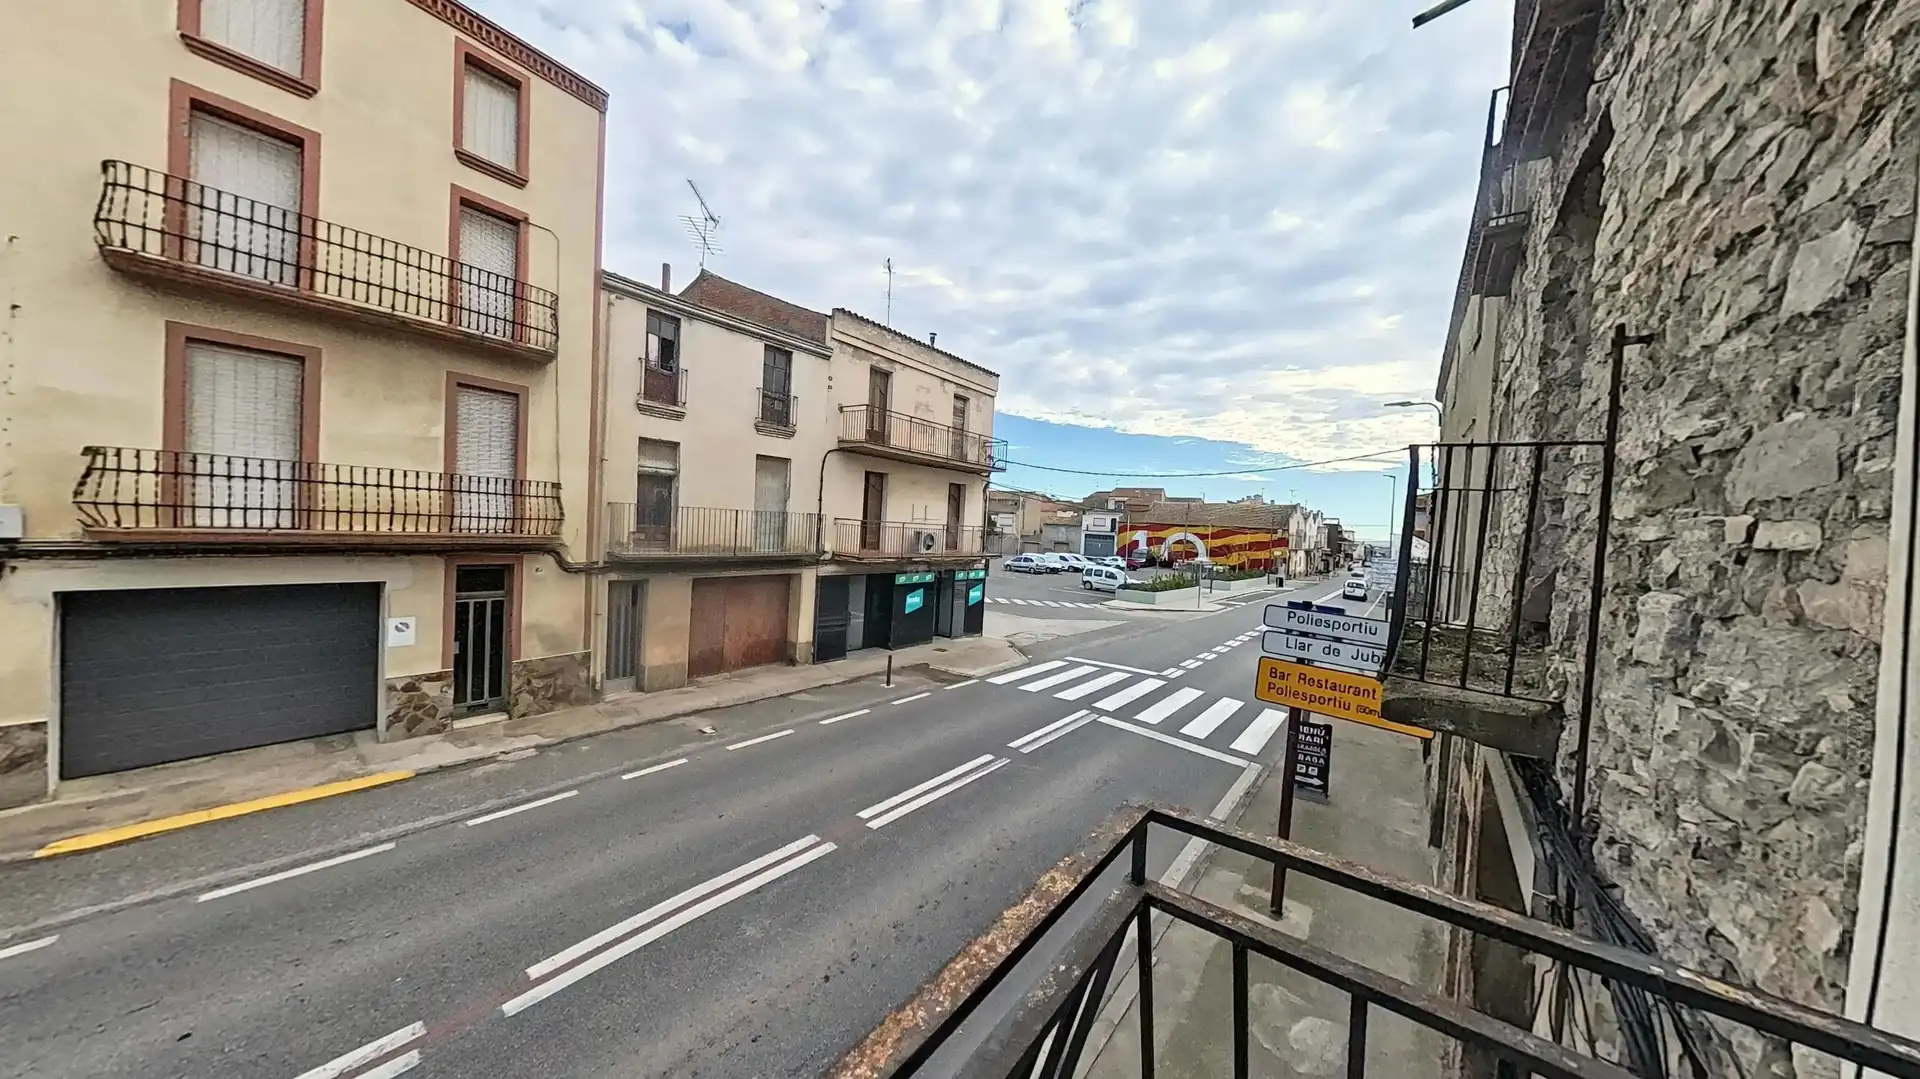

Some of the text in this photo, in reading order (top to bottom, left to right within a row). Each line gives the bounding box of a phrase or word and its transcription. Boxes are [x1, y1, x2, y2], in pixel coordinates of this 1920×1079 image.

[1287, 610, 1378, 636] Poliesportiu
[1285, 637, 1381, 664] Llar de Jub
[1267, 682, 1351, 712] Poliesportiu
[1269, 667, 1377, 700] Bar Restaurant
